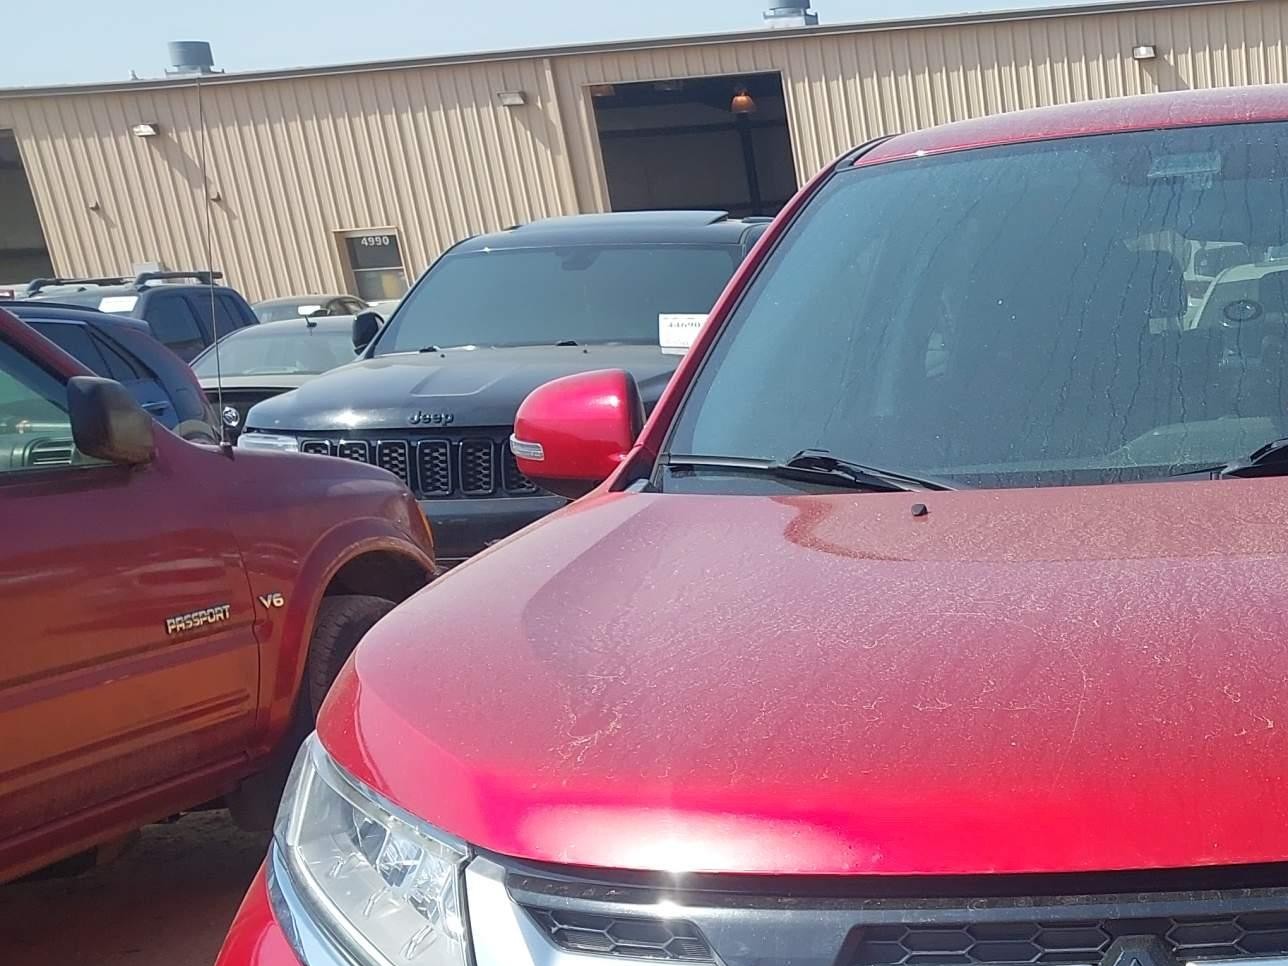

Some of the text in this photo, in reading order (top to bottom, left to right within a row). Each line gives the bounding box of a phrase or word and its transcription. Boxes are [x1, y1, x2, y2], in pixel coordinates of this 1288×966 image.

[360, 236, 390, 246] 4990
[408, 411, 454, 427] Jeep
[258, 592, 284, 609] V6
[165, 604, 231, 635] PASSPORT
